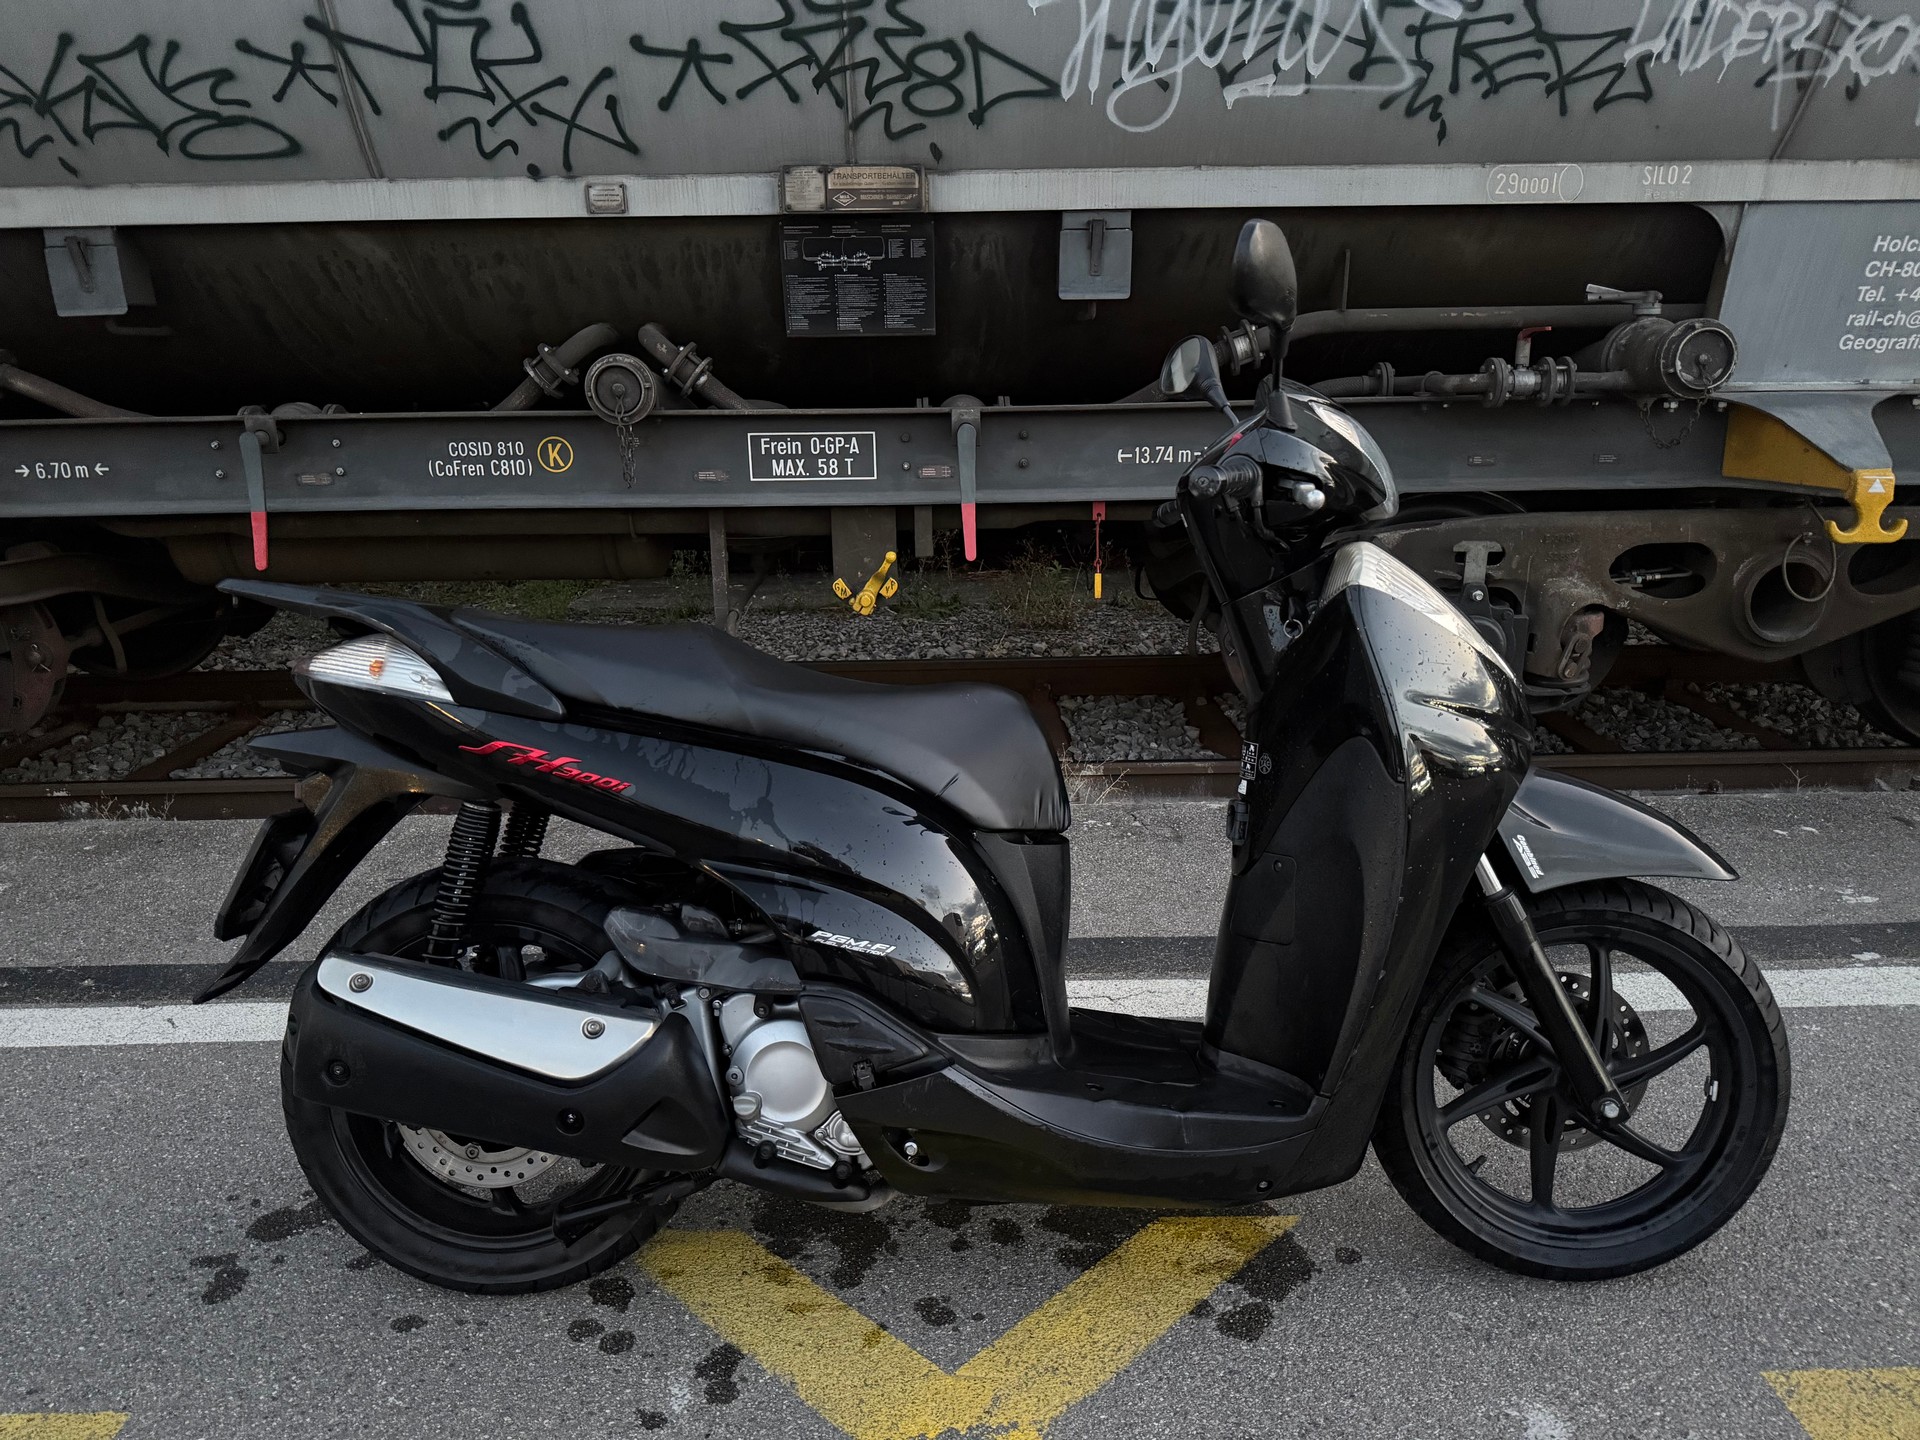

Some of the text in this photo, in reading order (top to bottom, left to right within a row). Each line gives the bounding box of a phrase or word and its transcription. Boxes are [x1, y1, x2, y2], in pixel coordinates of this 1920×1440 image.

[1642, 164, 1693, 185] SILO 2
[1872, 234, 1920, 252] Holc
[1857, 285, 1886, 302] Tel.
[448, 441, 524, 457] COSID 810
[547, 443, 565, 467] K
[760, 438, 802, 455] Frein
[1134, 446, 1191, 464] 13.74 m
[35, 462, 89, 479] 6.70 m
[428, 459, 533, 477] (CoFren C810)
[772, 458, 854, 476] MAX. 58 T
